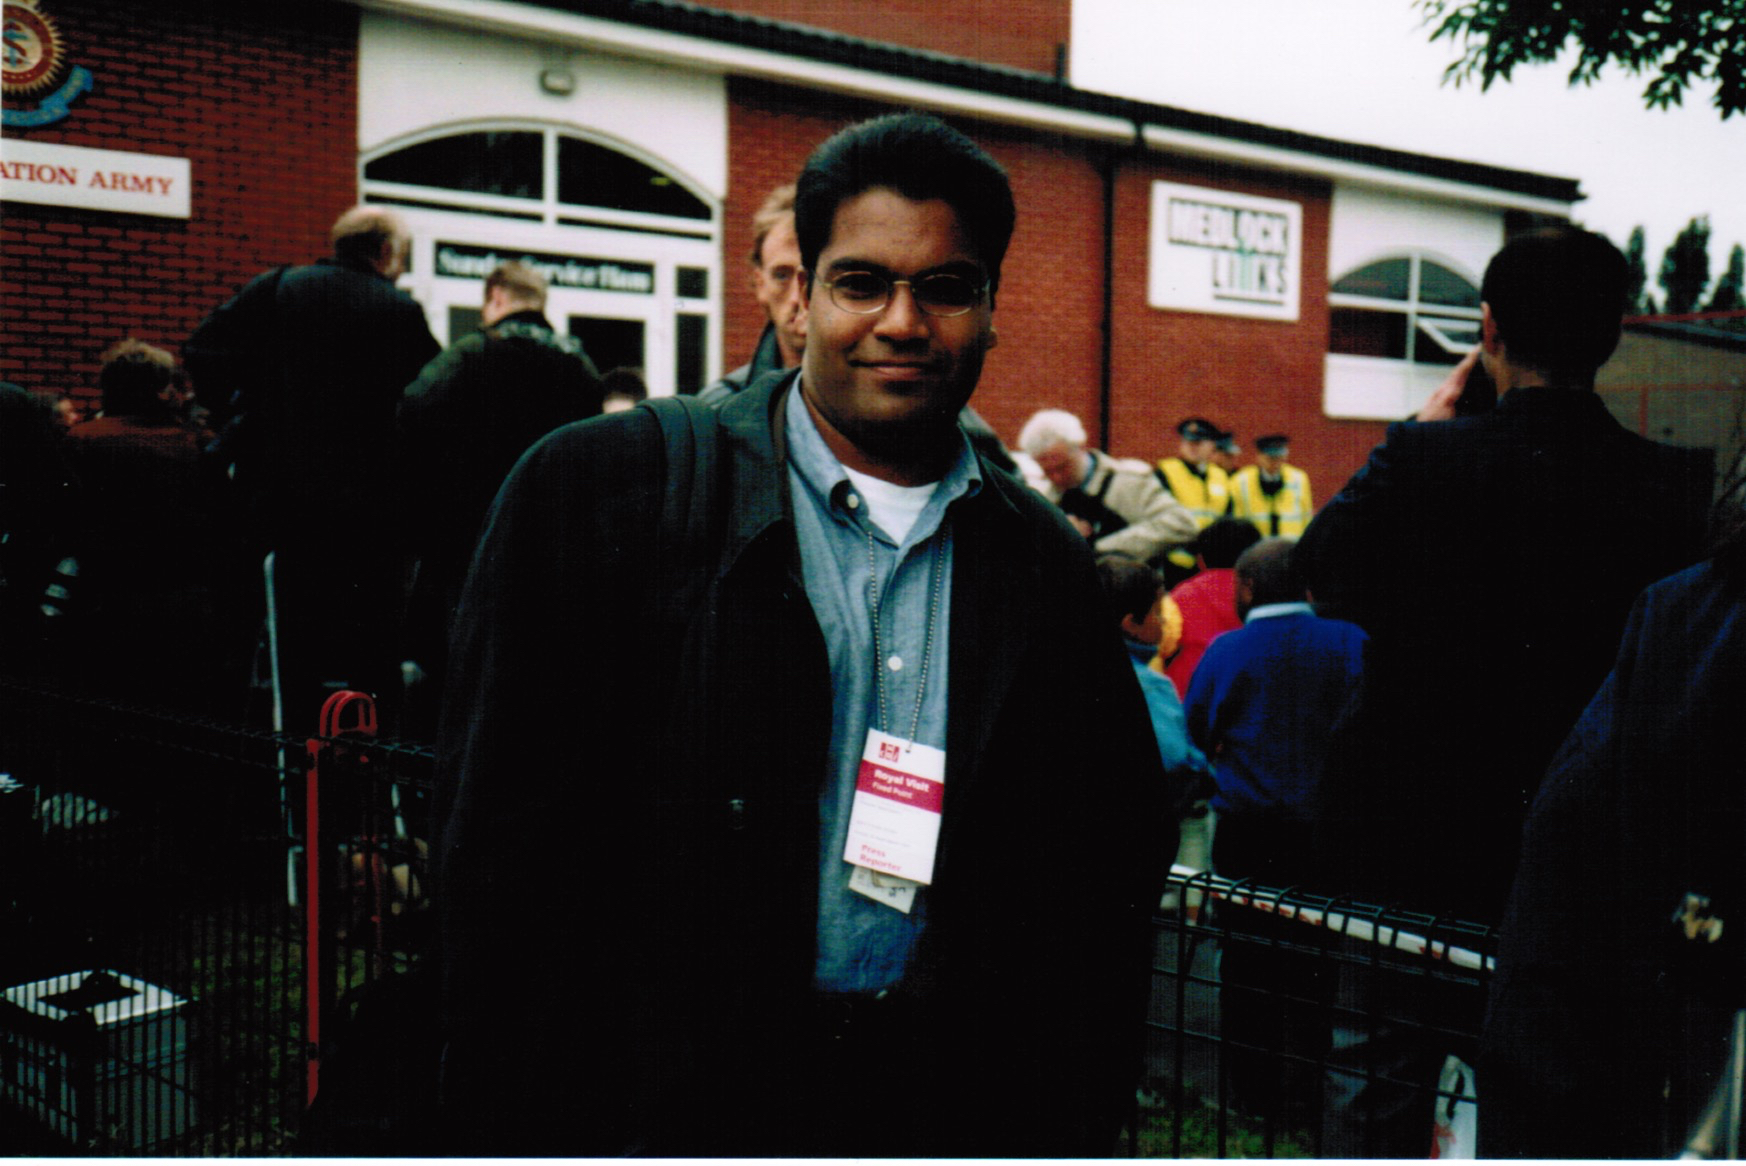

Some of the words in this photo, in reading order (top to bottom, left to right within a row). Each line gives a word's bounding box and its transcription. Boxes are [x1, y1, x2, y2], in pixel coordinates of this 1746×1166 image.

[89, 170, 173, 196] ARMY
[1167, 196, 1289, 256] MEDLOCK
[874, 768, 904, 785] Royal
[905, 777, 930, 793] Visit
[860, 854, 901, 871] Reporter
[861, 844, 886, 858] Press
